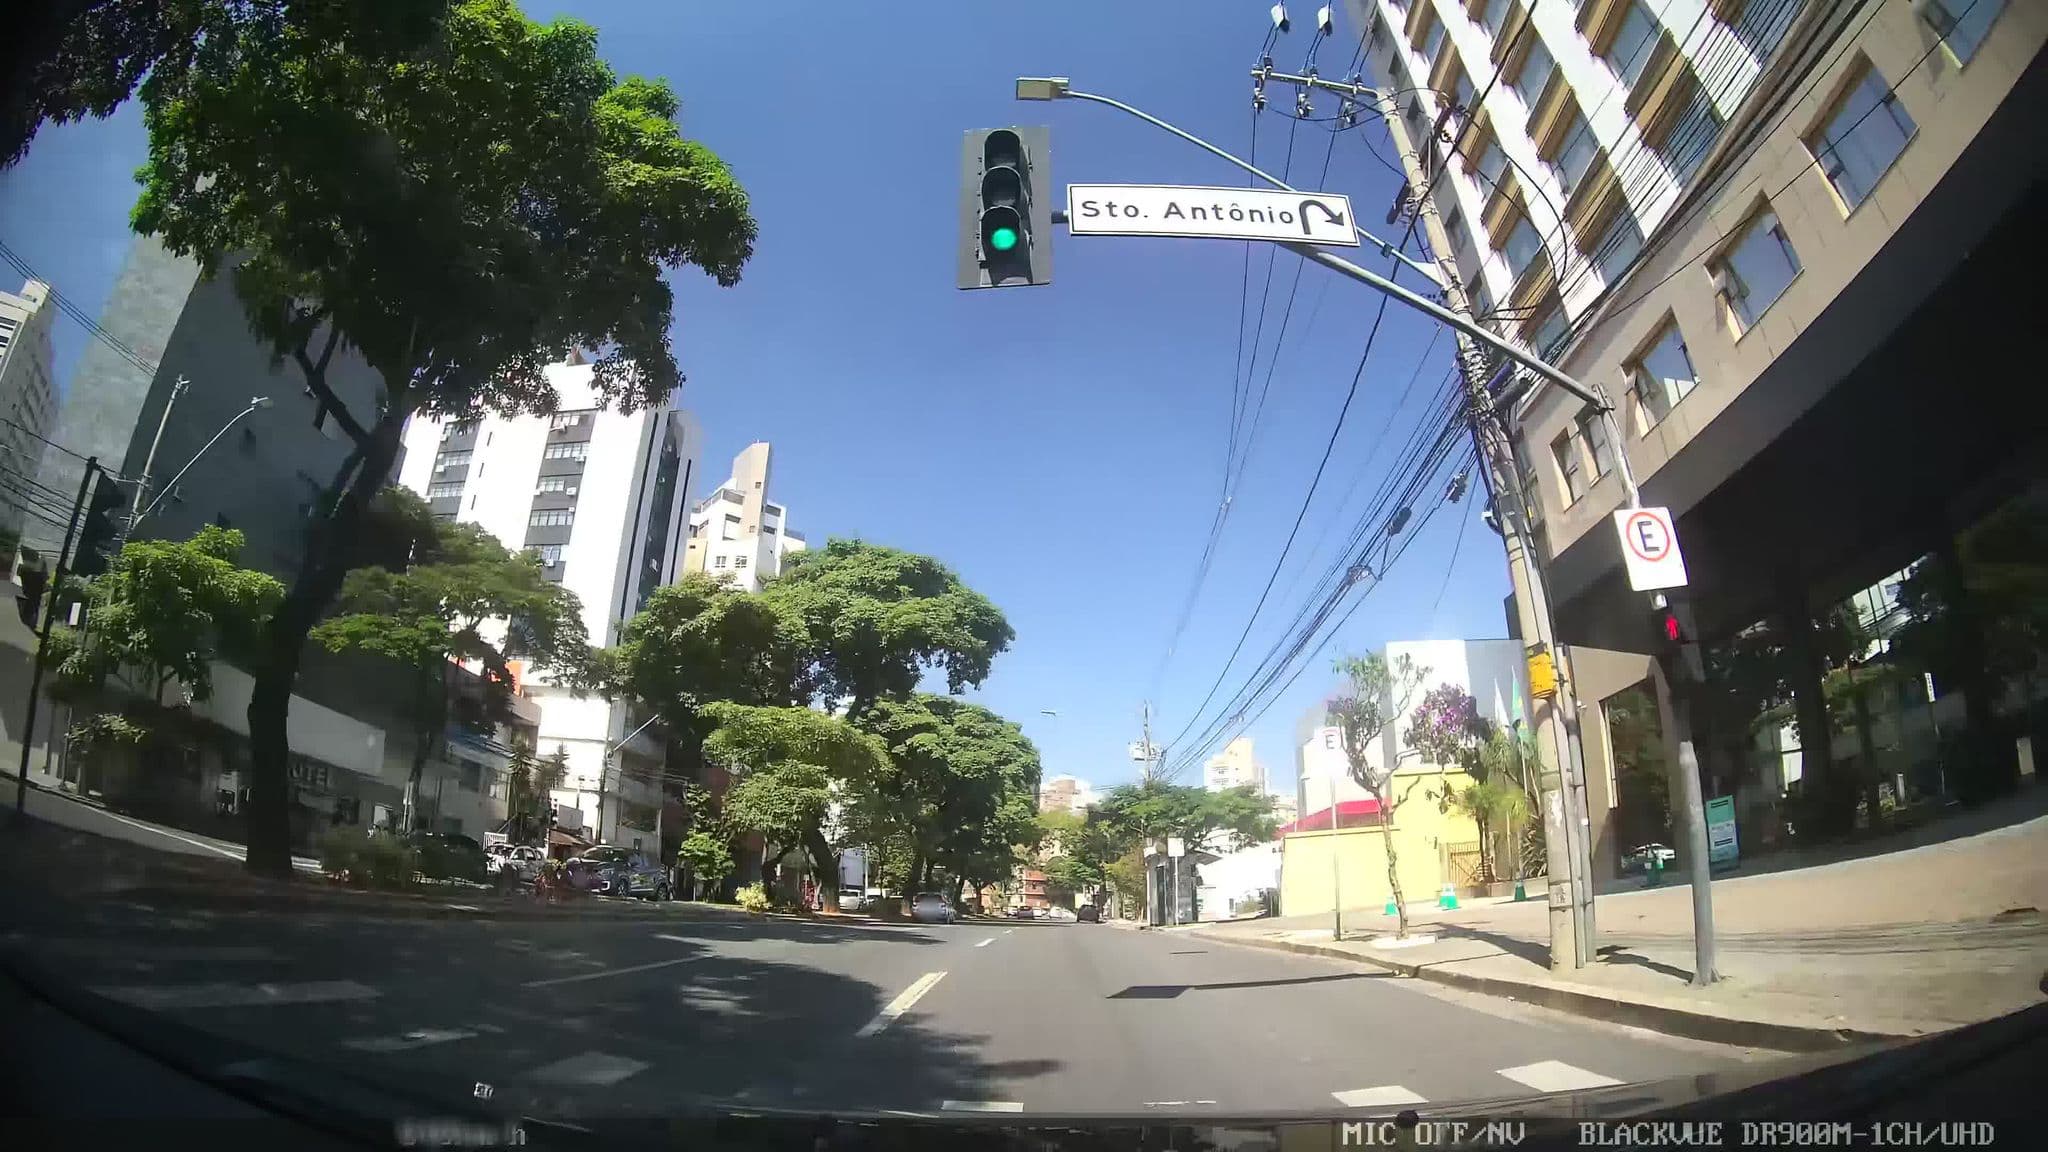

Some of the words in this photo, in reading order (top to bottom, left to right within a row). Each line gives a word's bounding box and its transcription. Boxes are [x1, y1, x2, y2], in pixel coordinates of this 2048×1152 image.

[1081, 200, 1149, 219] Sto.
[1163, 202, 1294, 225] Antônio
[1637, 520, 1660, 552] E
